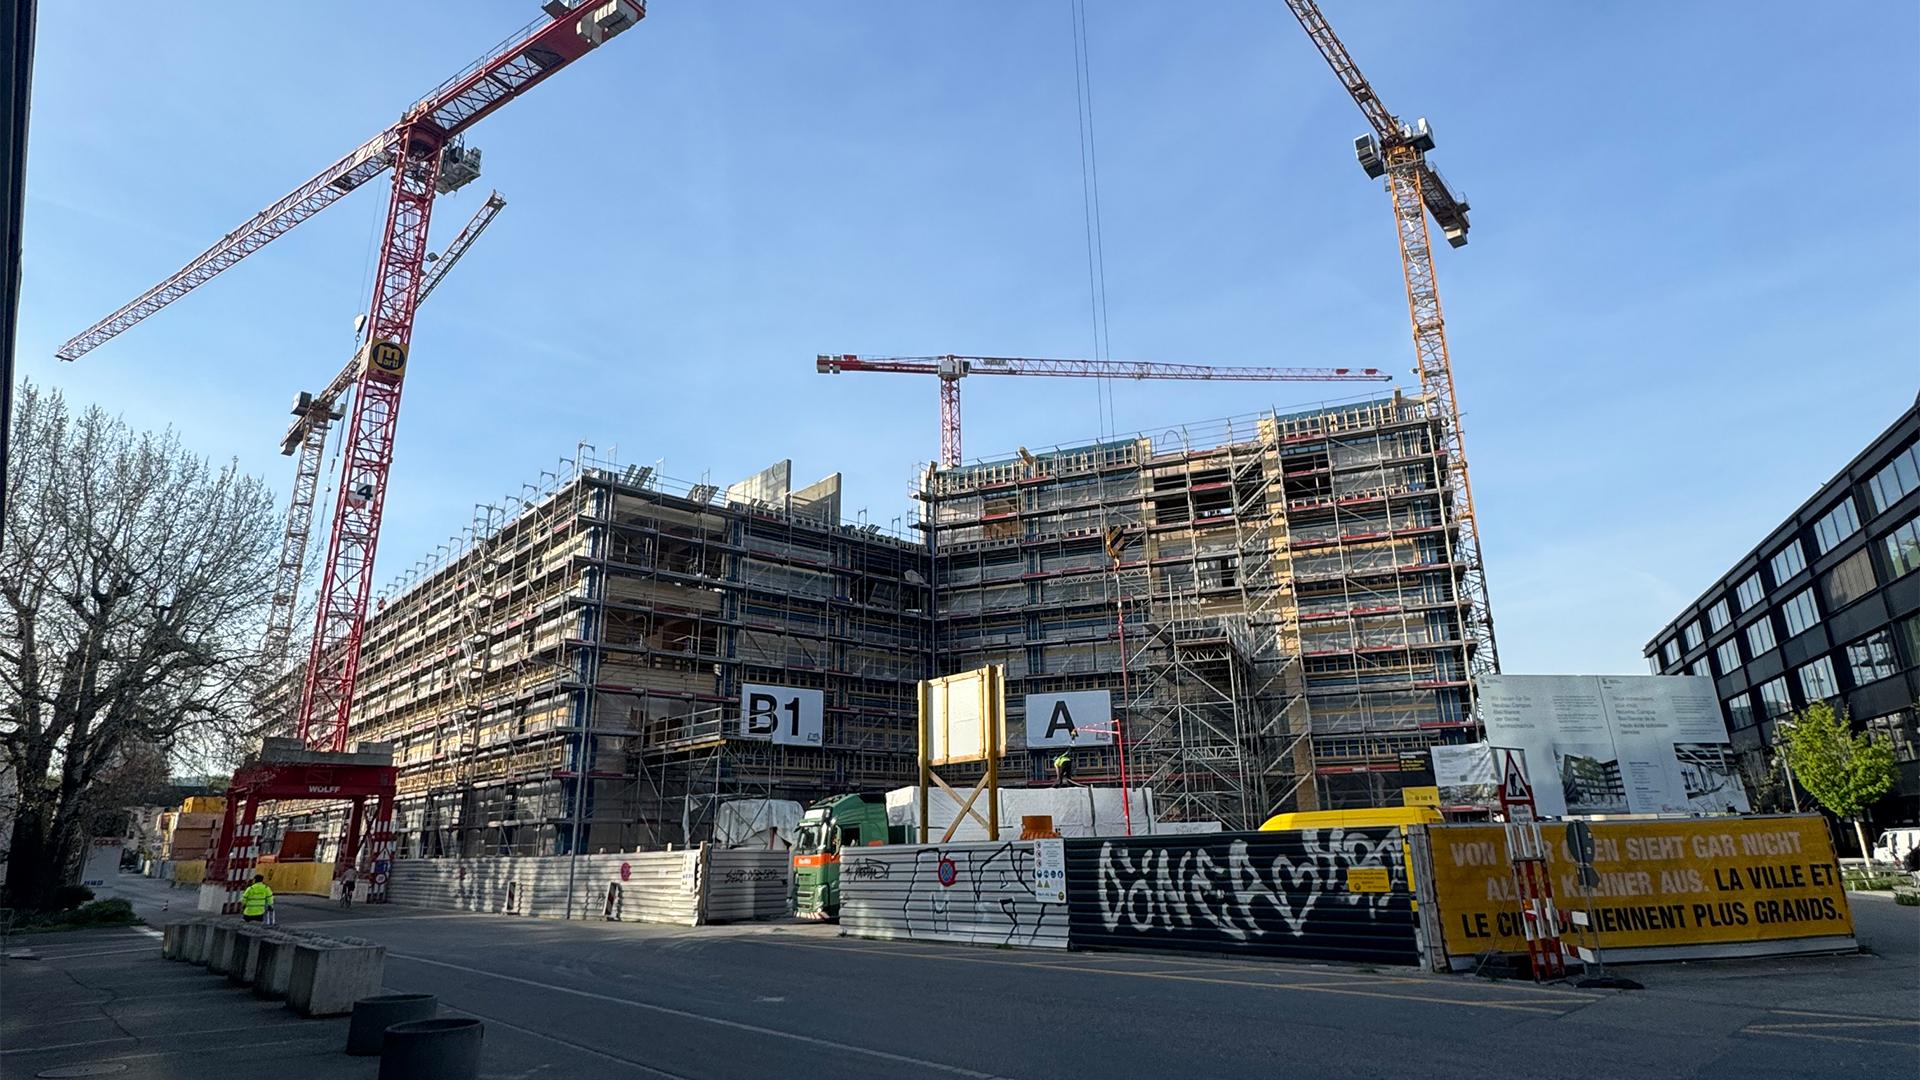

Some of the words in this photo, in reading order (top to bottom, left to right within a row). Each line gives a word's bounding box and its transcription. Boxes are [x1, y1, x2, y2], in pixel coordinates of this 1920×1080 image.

[748, 692, 800, 737] B1
[1044, 700, 1079, 738] A
[309, 785, 341, 794] WOLFF
[1450, 841, 1497, 867] VON
[1625, 835, 1685, 861] SIEHT
[1691, 833, 1738, 859] GAR
[1740, 831, 1802, 857] NICHT
[1561, 871, 1654, 898] KINER
[1660, 868, 1710, 894] AUS.
[1714, 867, 1745, 892] LA
[1747, 864, 1806, 890] VILLE
[1809, 863, 1834, 887] ET
[1461, 913, 1492, 938] LE
[1497, 910, 1547, 937] CI
[1556, 904, 1686, 934] IENNENT
[1692, 902, 1749, 929] PLUS
[1753, 896, 1844, 925] GRANDS.
